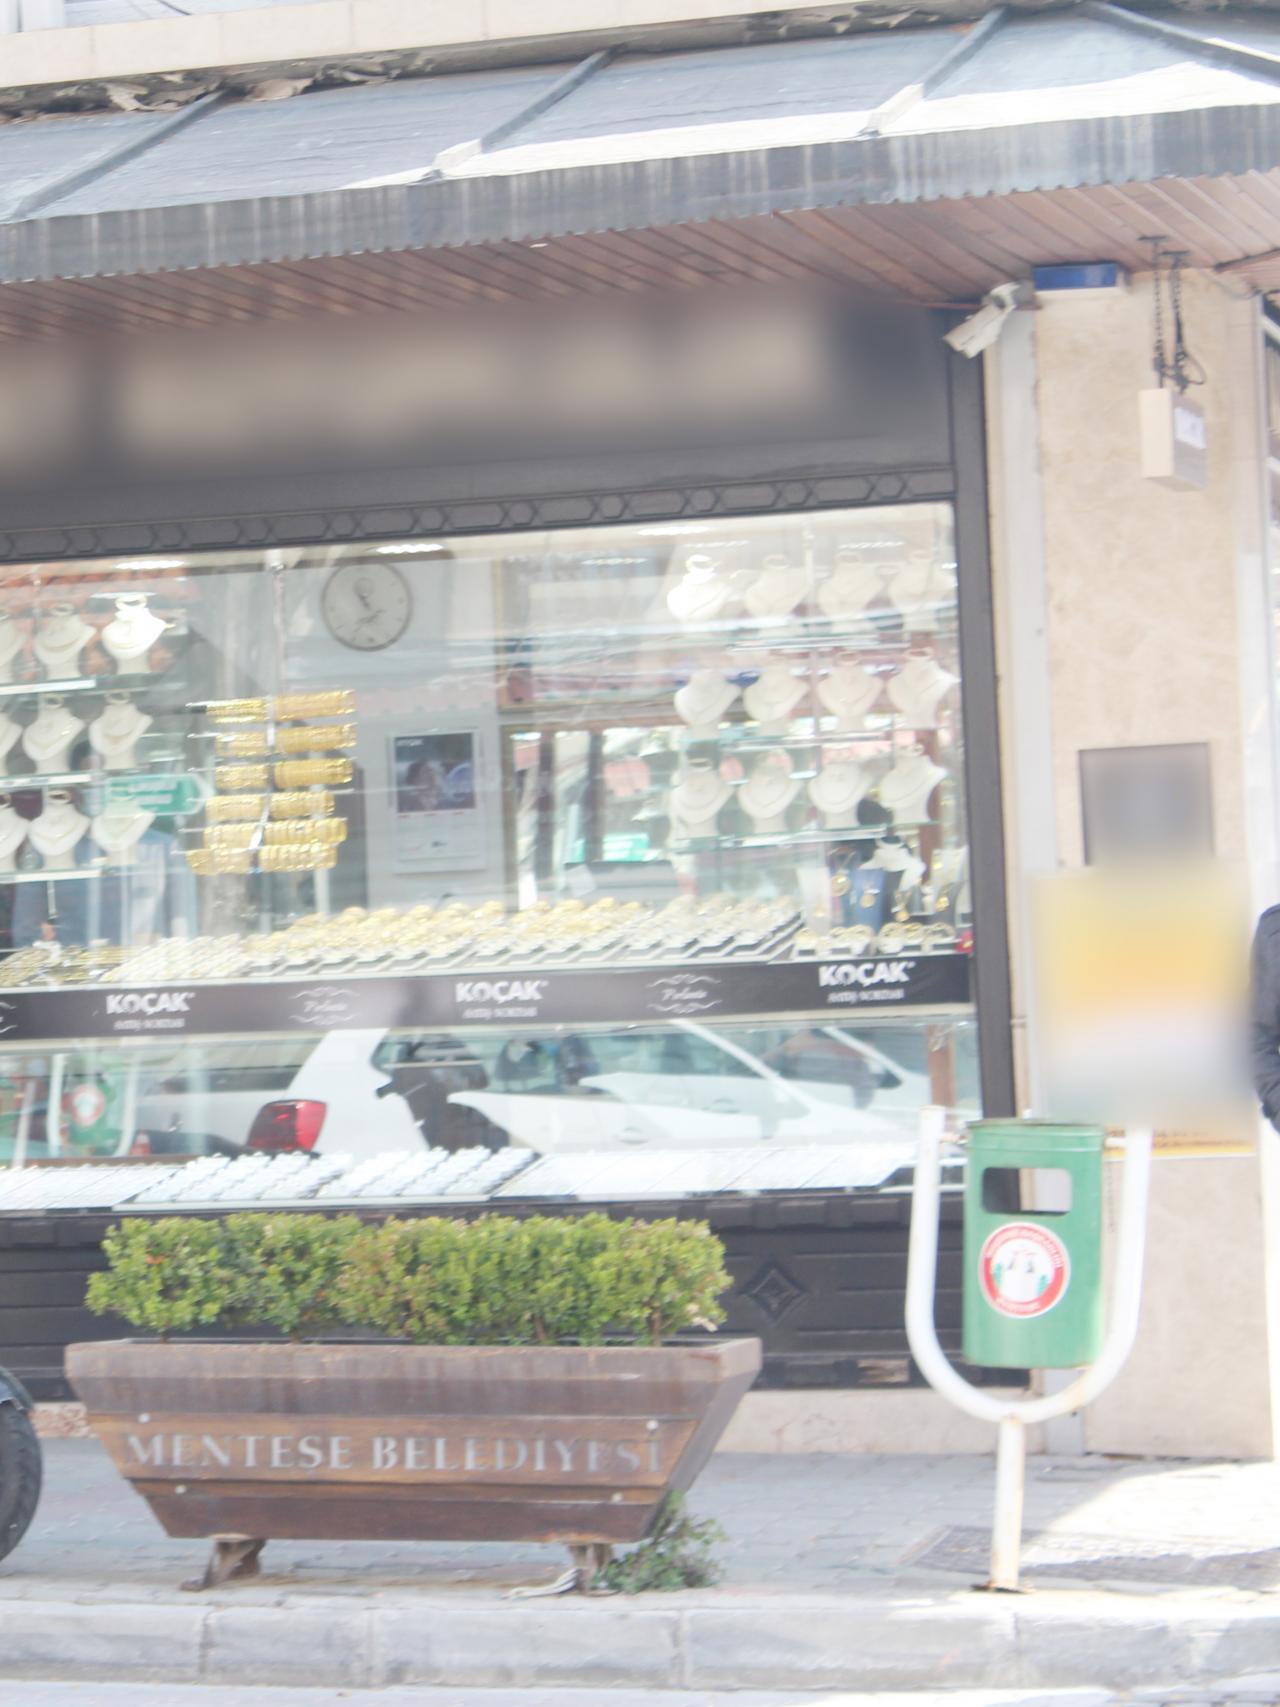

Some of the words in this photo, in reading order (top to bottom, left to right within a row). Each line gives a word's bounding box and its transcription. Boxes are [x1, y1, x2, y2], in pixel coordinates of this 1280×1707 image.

[818, 961, 911, 988] KOÇAK
[105, 992, 192, 1016] KOÇAK
[454, 979, 544, 1004] KOÇAK
[126, 1434, 353, 1475] MENTEŞE
[371, 1428, 664, 1474] BELEDİYESİ
